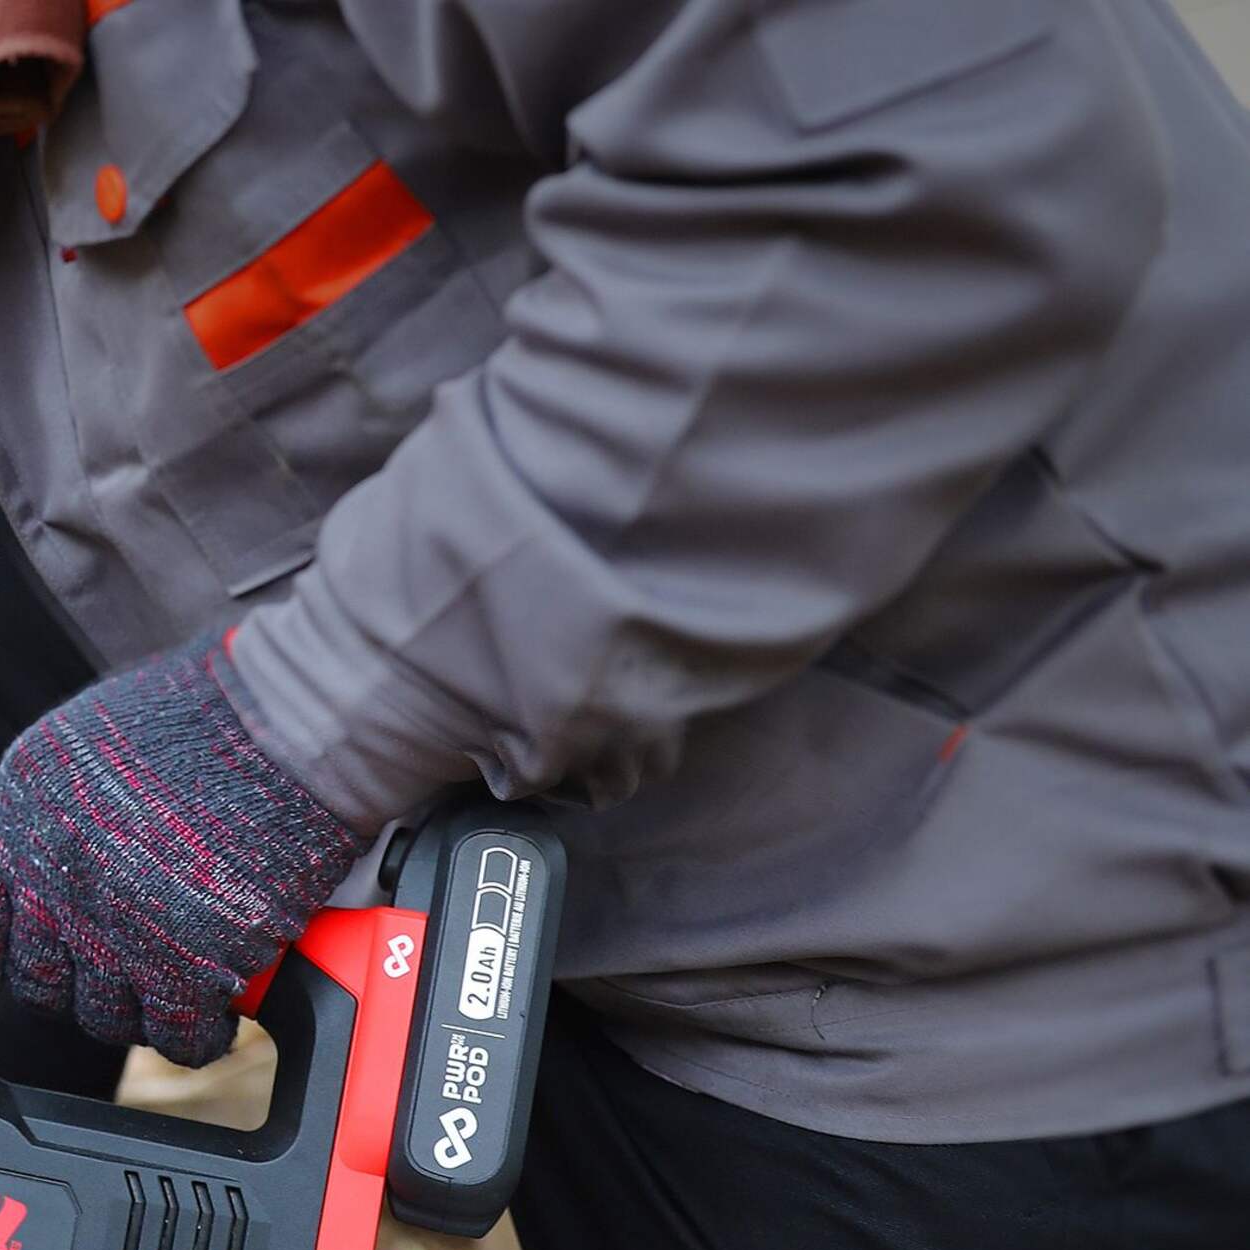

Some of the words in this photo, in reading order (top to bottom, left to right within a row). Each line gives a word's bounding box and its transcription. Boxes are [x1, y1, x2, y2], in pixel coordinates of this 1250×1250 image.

[502, 948, 518, 978] BATTERY
[442, 1043, 469, 1100] PWR
[462, 1047, 489, 1104] POD
